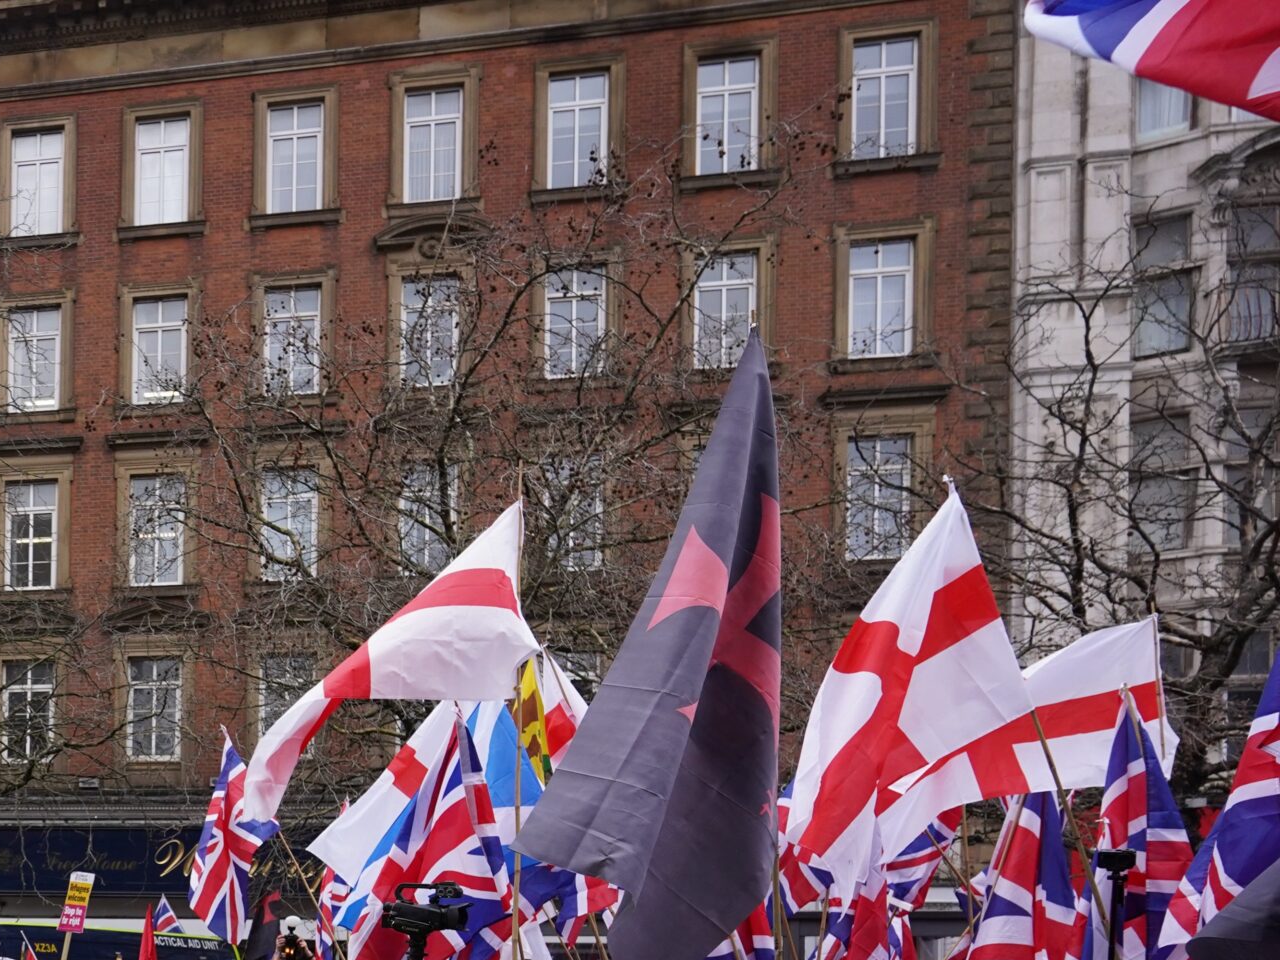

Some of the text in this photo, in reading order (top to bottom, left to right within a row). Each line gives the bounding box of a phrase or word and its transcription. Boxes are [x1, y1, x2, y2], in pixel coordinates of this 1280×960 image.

[154, 935, 219, 950] ACTICAL AID UNIT
